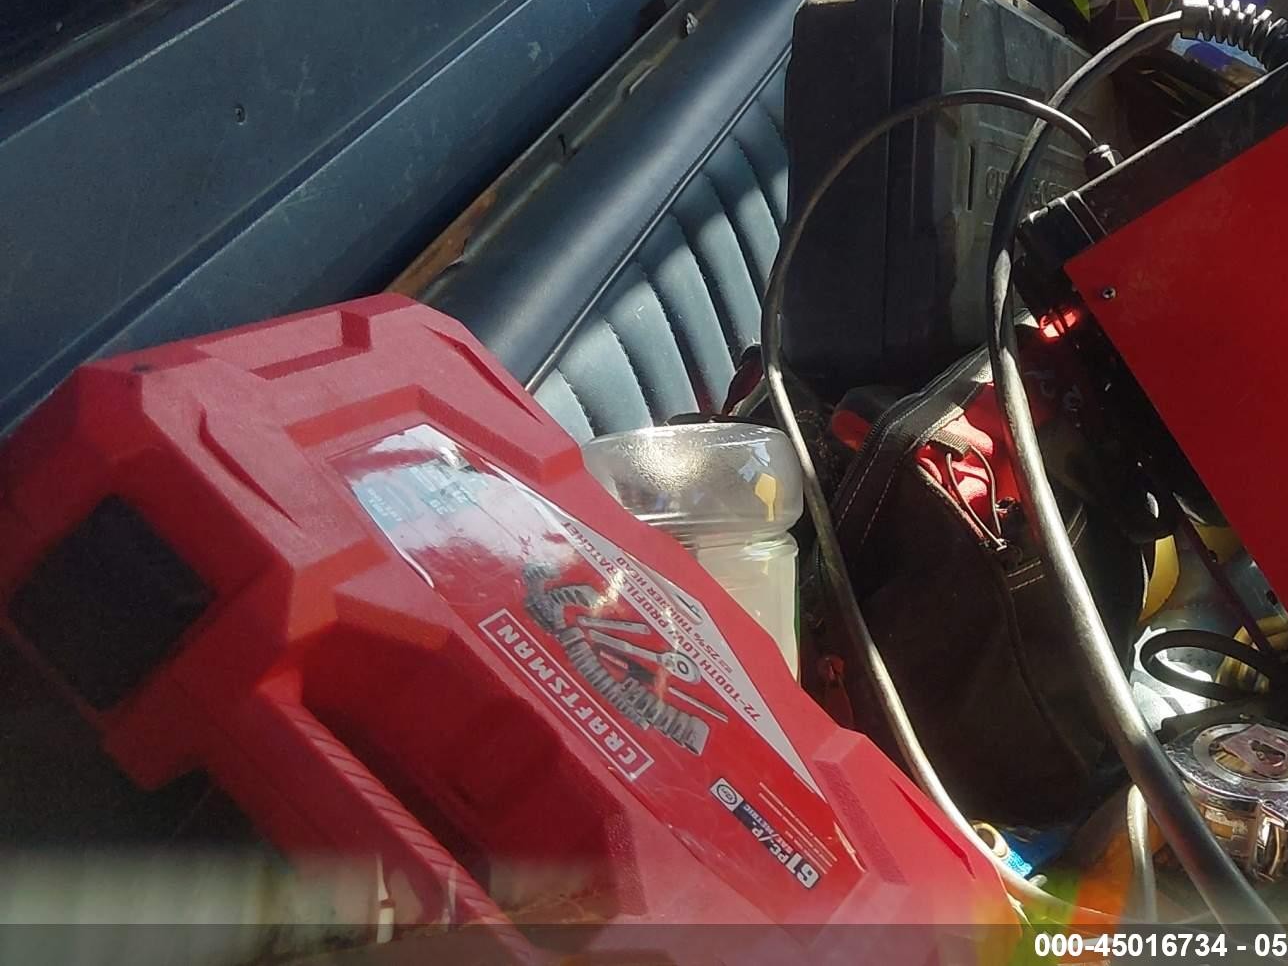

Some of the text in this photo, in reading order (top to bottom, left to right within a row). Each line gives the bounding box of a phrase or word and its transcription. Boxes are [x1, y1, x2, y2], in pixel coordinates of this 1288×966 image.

[560, 520, 617, 576] RATCHET
[616, 556, 647, 587] HEAD
[691, 631, 720, 660] 25%
[496, 621, 638, 766] CRAFTSMAN
[700, 658, 761, 721] 72-TOOTH
[784, 852, 820, 889] 61
